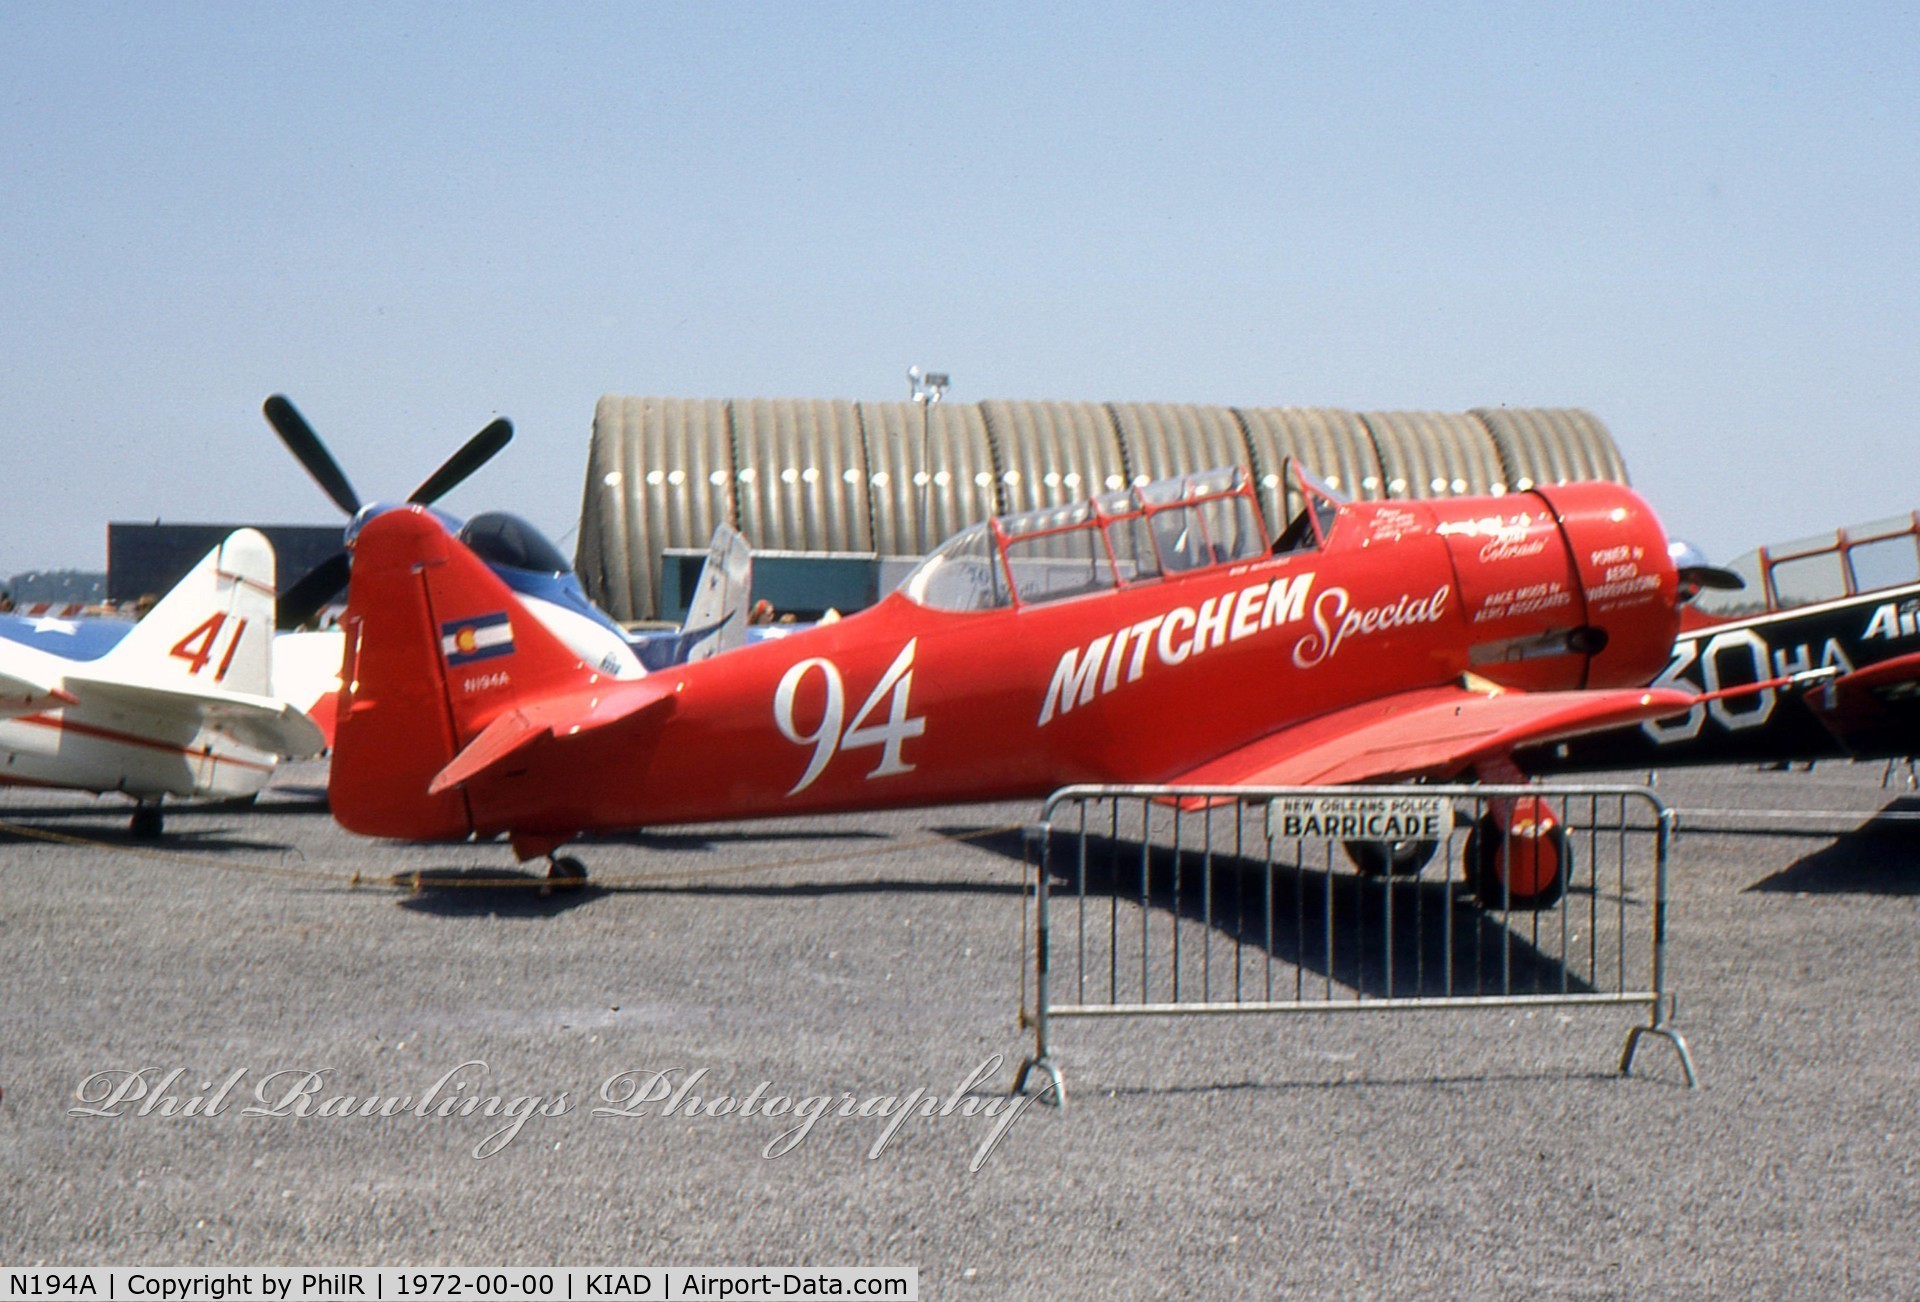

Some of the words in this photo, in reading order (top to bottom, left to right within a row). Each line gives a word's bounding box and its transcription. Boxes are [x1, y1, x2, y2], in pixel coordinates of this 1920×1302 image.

[1860, 602, 1920, 641] Ai
[169, 611, 248, 683] 41
[1037, 572, 1316, 727] MITCHEM
[1292, 584, 1450, 669] Special
[464, 671, 511, 693] N194A
[773, 636, 926, 797] 94
[1283, 800, 1314, 813] NEW
[1319, 800, 1387, 813] ORLEANS
[1390, 799, 1440, 813] POLICE
[1283, 814, 1440, 837] BARRICADE
